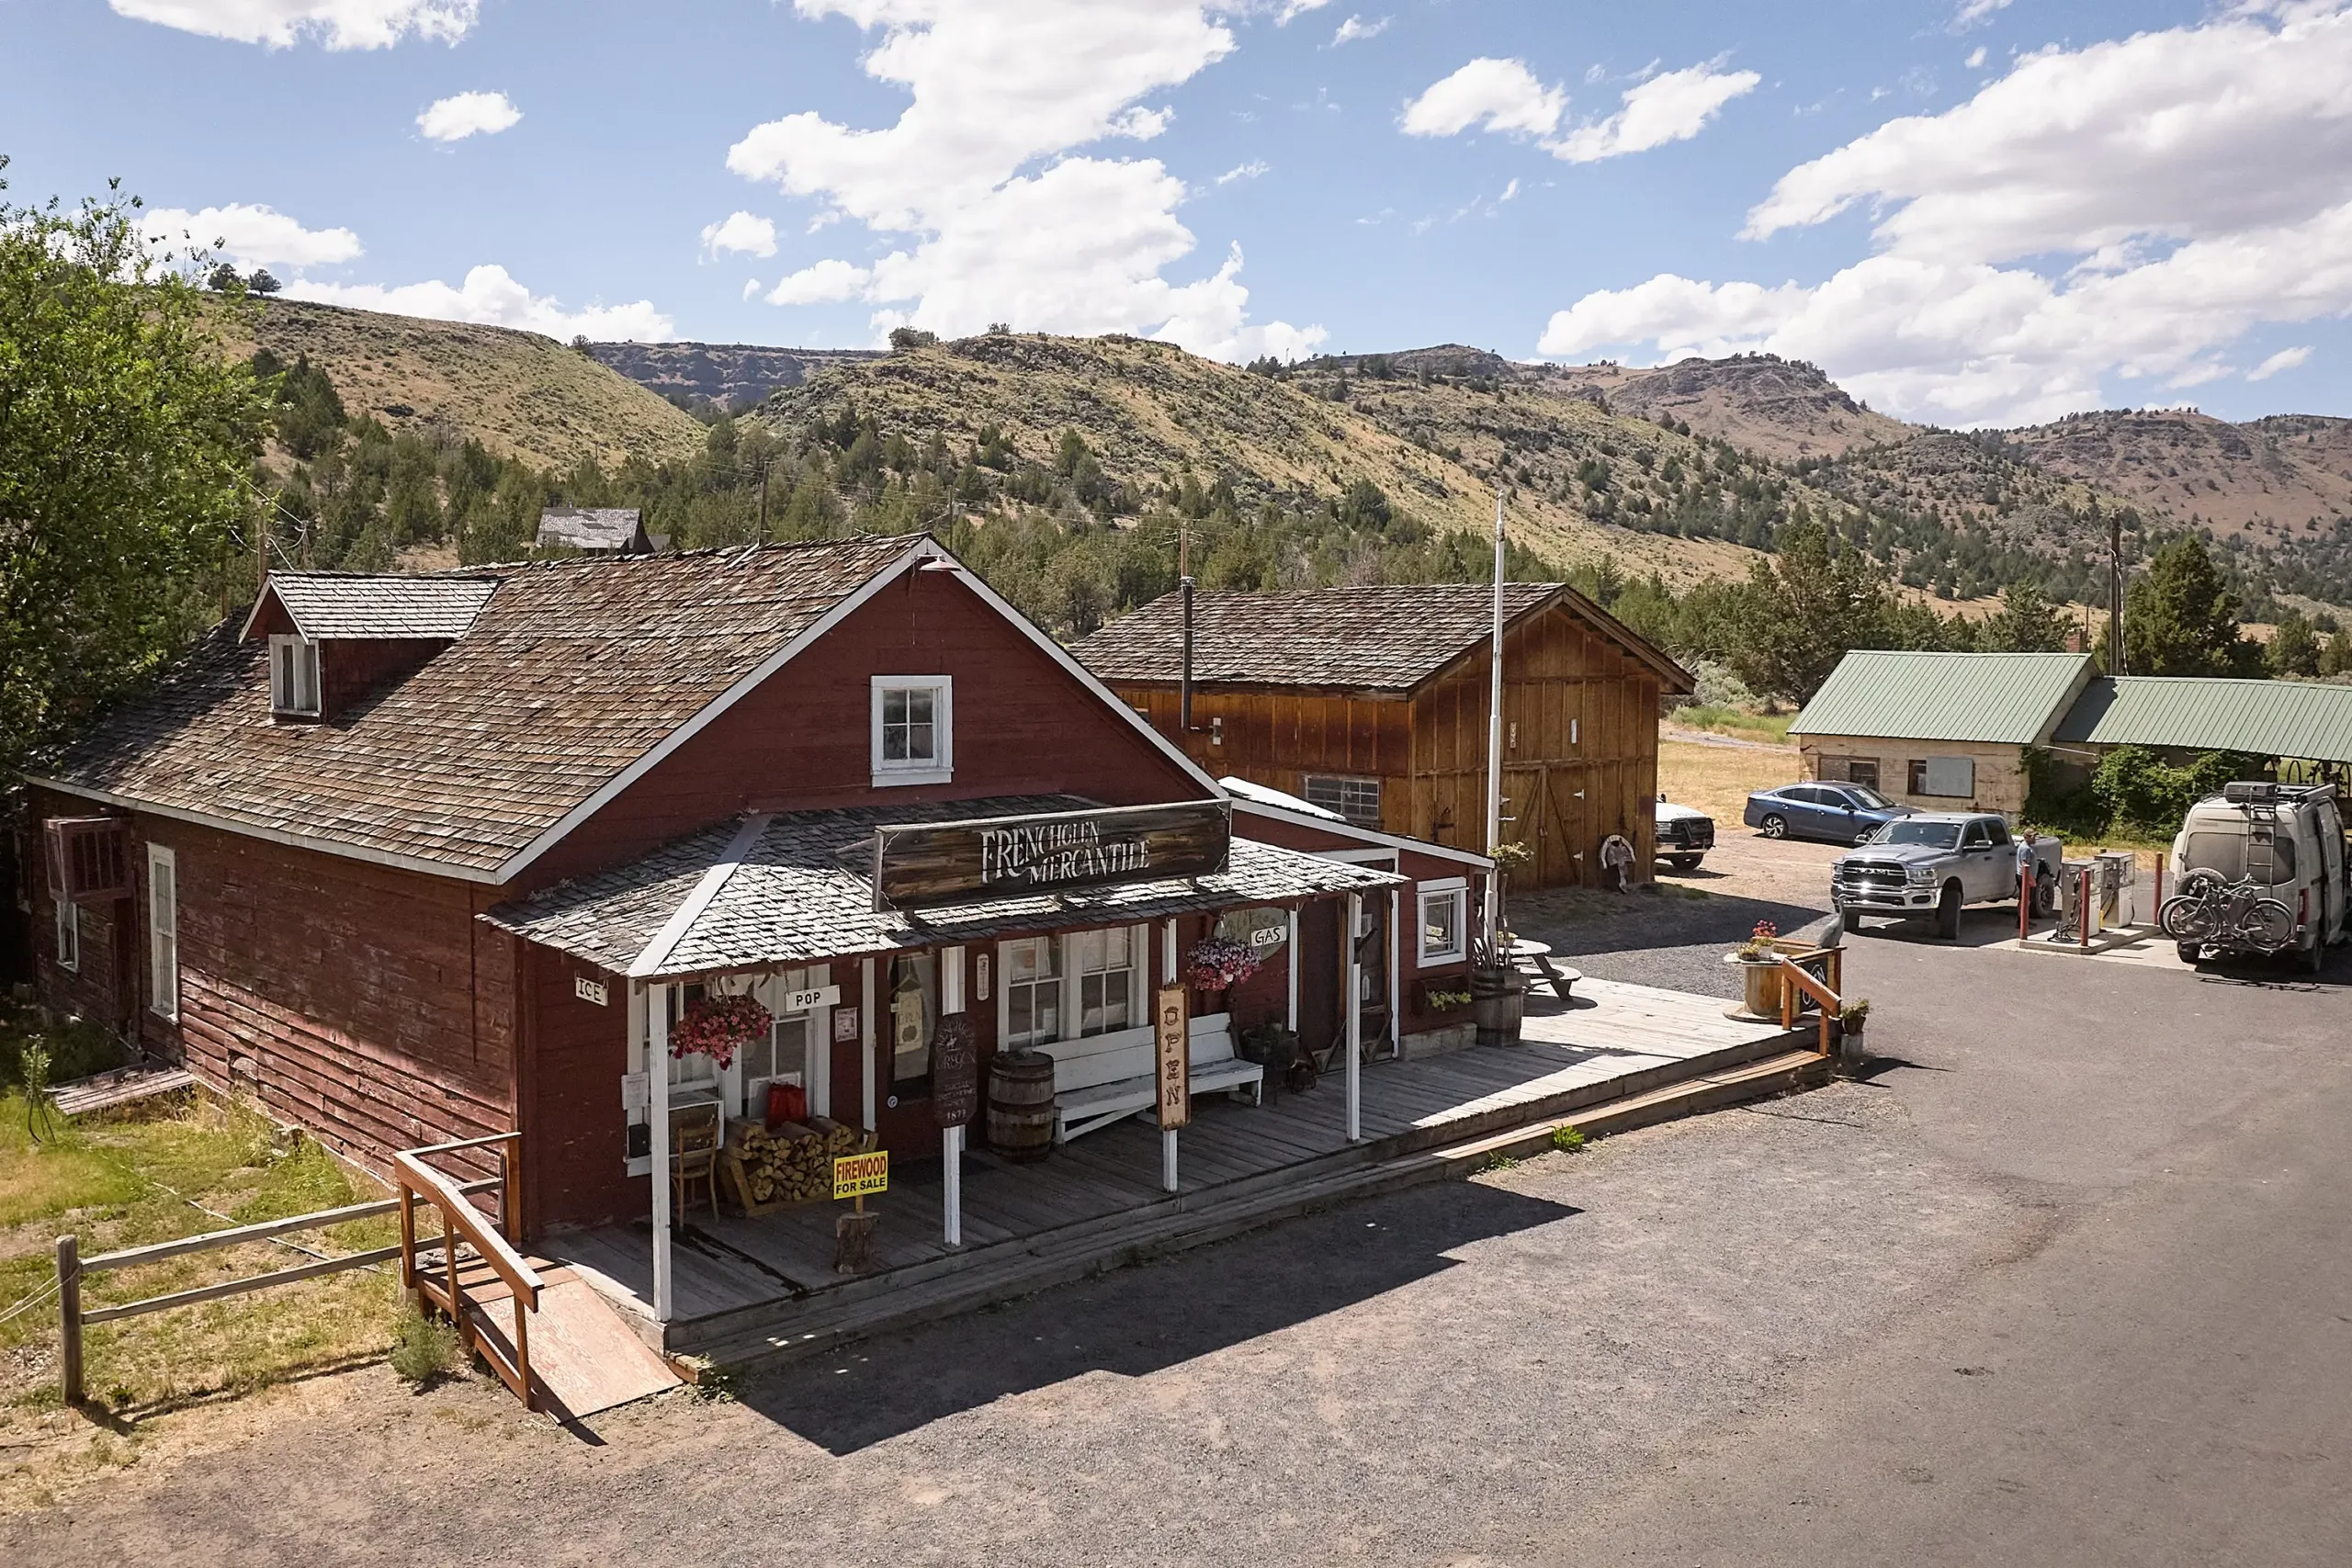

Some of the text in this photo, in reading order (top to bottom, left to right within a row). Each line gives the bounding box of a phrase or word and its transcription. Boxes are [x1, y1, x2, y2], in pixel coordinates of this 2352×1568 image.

[981, 820, 1100, 884] FRENCHGLEN
[1029, 840, 1150, 885] MERCANTILE
[1255, 928, 1280, 945] GAS
[579, 979, 602, 1002] ICE
[796, 992, 820, 1006] POP
[1164, 1006, 1182, 1106] OPEN
[836, 1156, 887, 1182] FIREWOOD
[836, 1177, 886, 1194] FOR SALE
